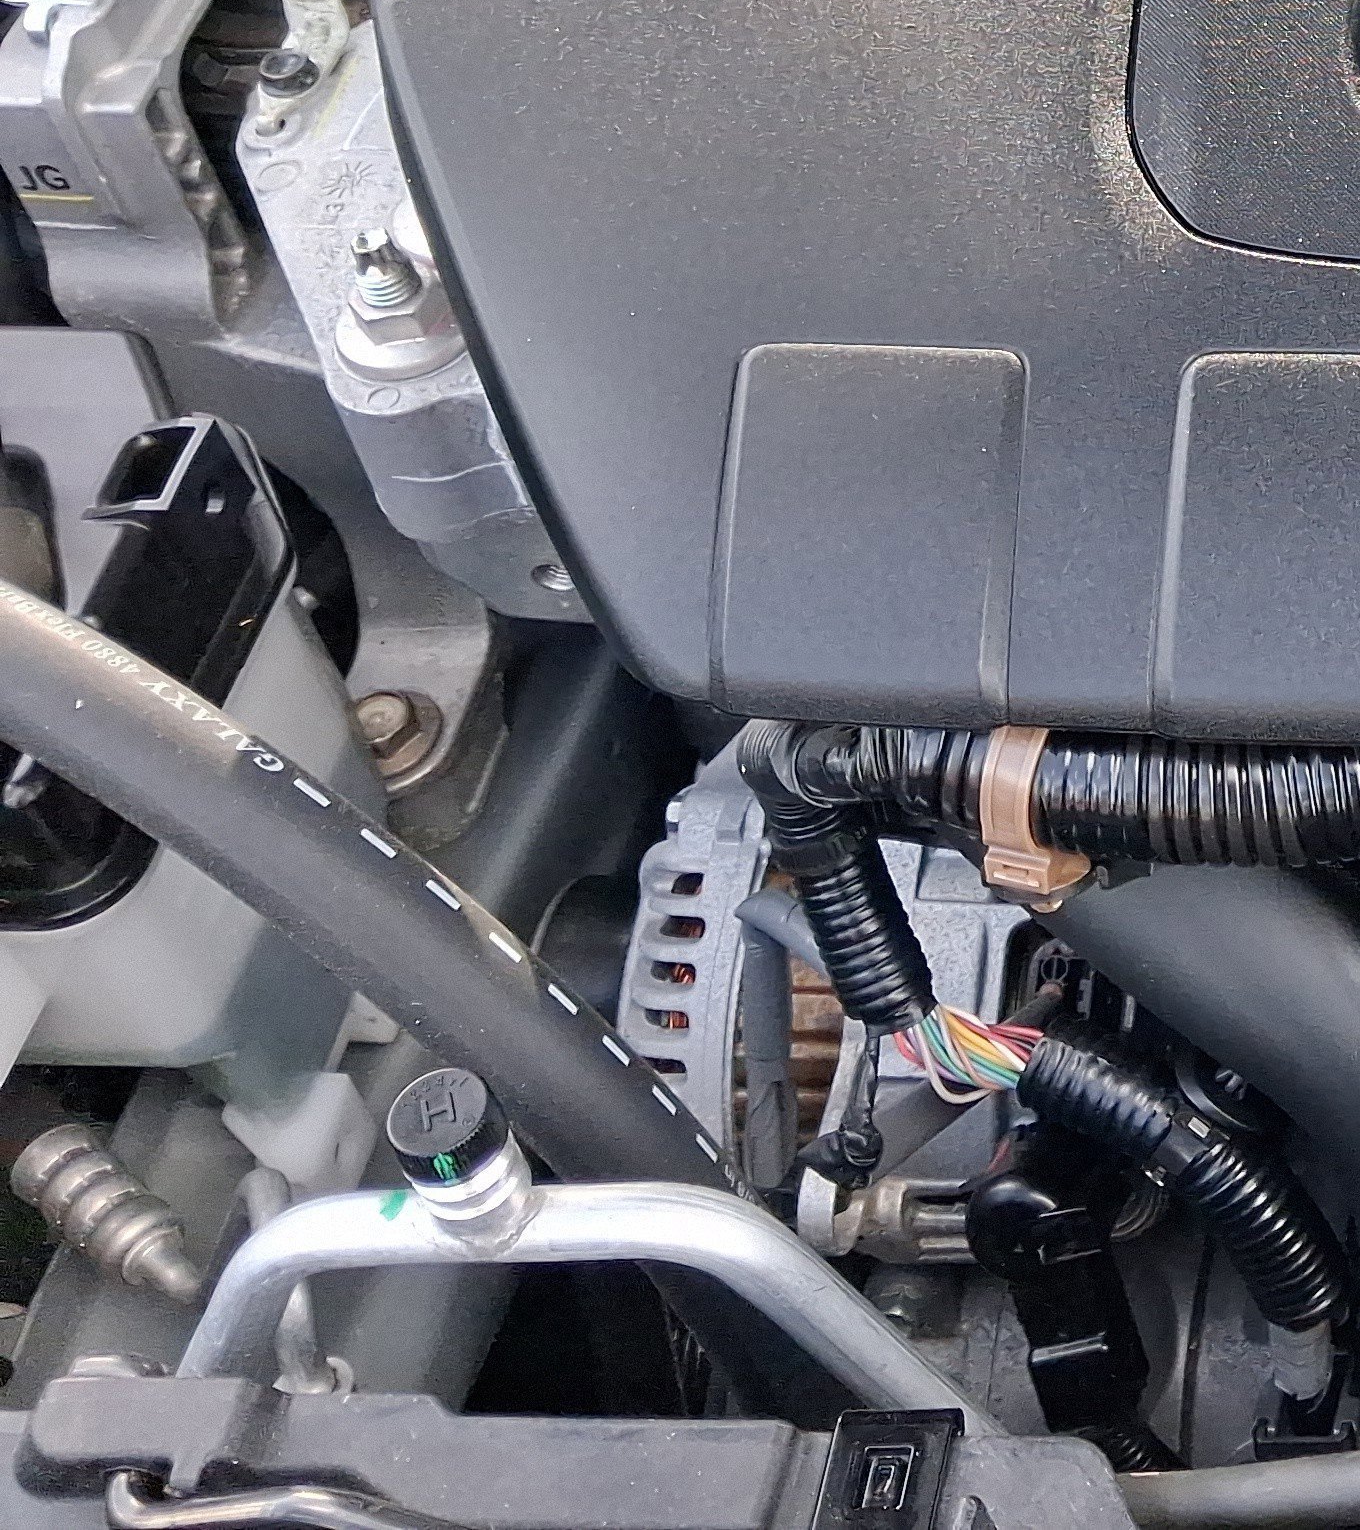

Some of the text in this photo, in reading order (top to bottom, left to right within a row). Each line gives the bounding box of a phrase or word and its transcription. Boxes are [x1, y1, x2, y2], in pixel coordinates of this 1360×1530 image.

[81, 639, 141, 673] 4880
[139, 680, 284, 772] GALAXY
[420, 1090, 457, 1132] H
